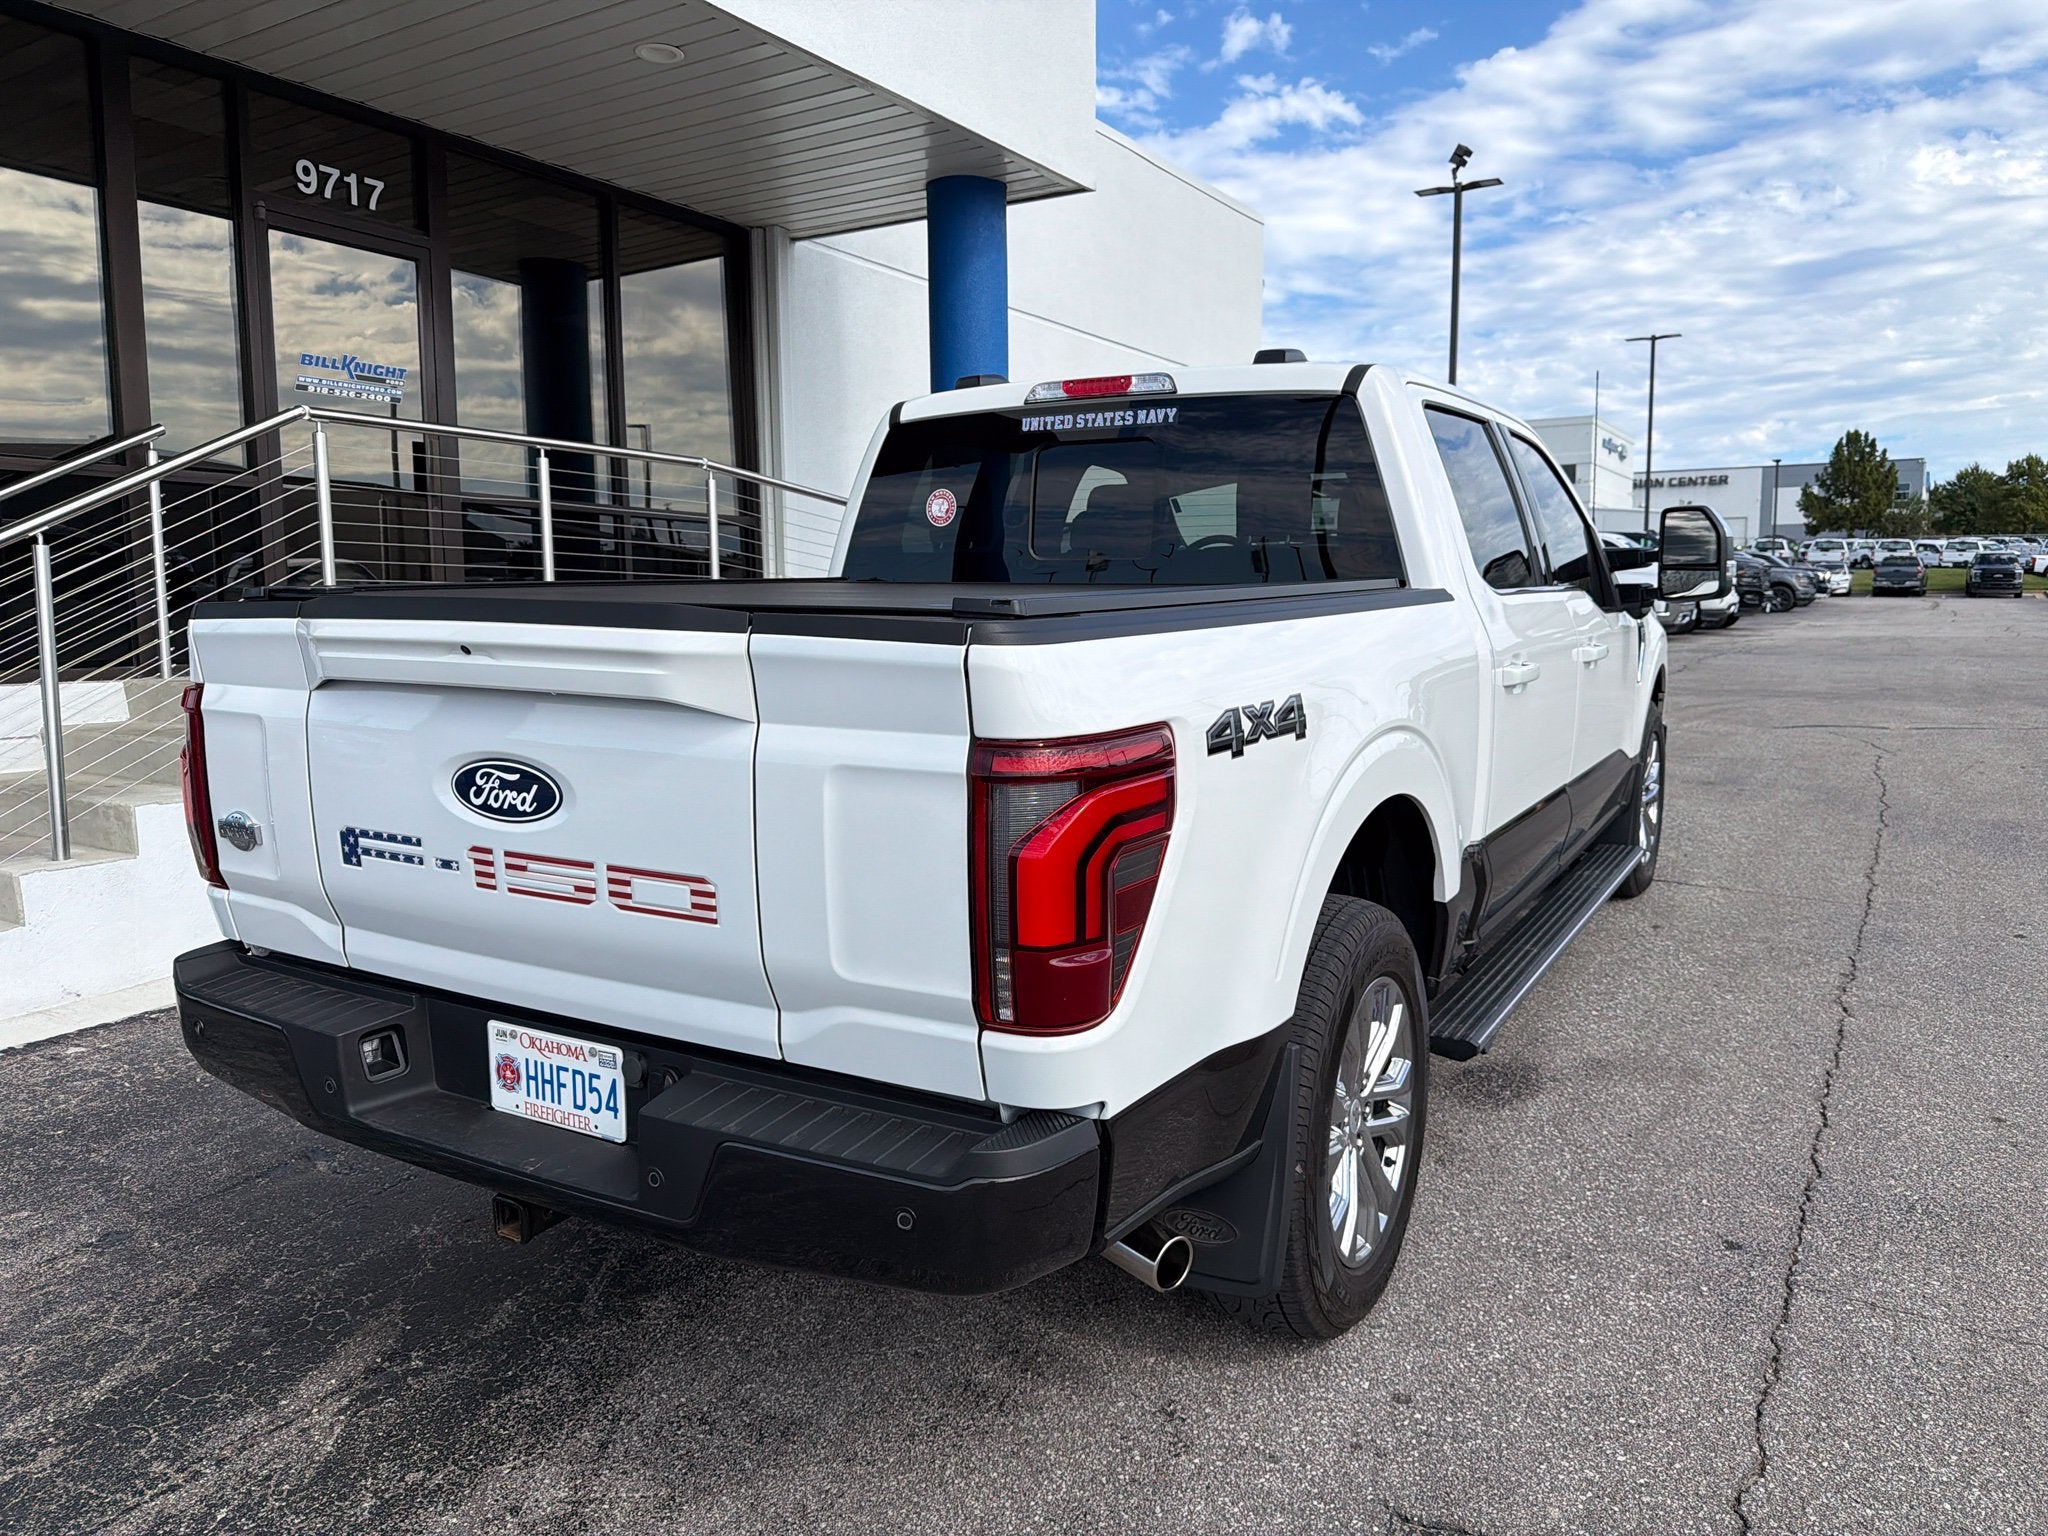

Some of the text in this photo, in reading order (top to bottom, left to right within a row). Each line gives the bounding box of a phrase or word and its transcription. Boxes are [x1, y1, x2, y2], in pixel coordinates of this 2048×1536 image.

[295, 158, 385, 211] 9717
[307, 385, 391, 402] 918-526-2400
[1021, 407, 1178, 431] UNITED STATES NAVY
[1668, 475, 1729, 488] CENTER
[469, 767, 539, 813] Ford
[339, 825, 720, 928] F-150
[495, 1028, 508, 1039] JUN
[519, 1031, 589, 1063] OKLAHOMA
[525, 1057, 620, 1120] HHFD54
[523, 1101, 594, 1133] FIREFIGHTER
[1175, 1212, 1224, 1241] Ford
